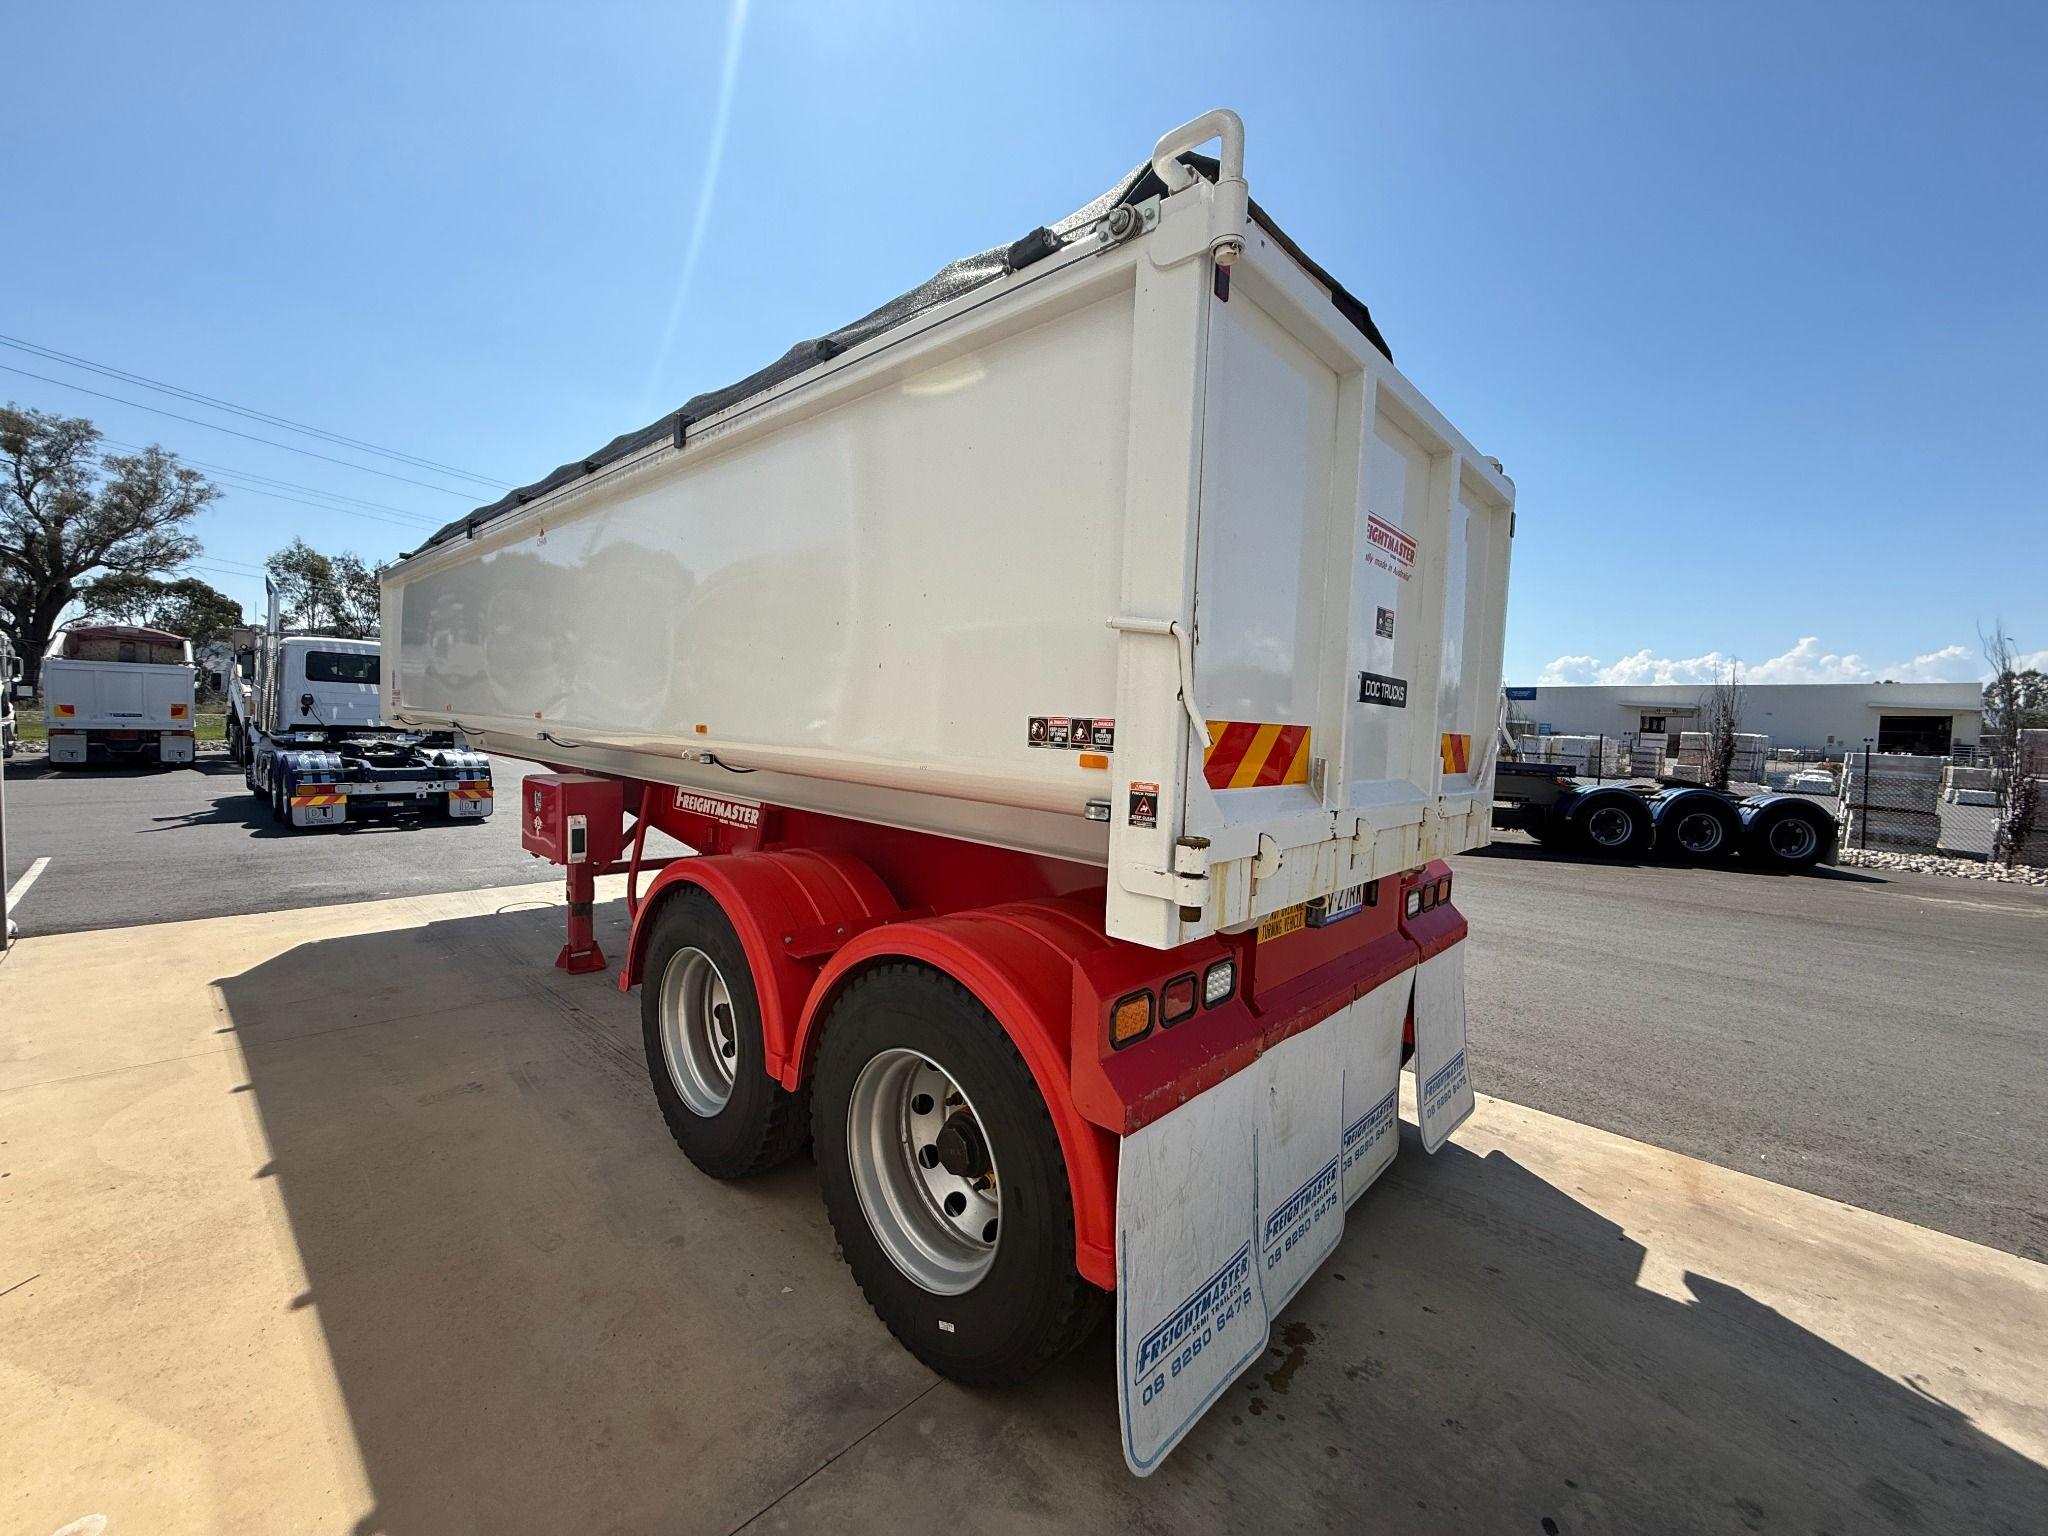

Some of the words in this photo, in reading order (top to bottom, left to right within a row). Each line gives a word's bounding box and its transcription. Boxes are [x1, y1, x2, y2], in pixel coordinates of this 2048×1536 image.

[1365, 680, 1381, 697] DOC
[1381, 683, 1405, 701] TRUCKS
[676, 786, 760, 825] FREIGHTMASTER
[1266, 1167, 1337, 1245] FREIGHTMASTER
[1268, 1247, 1282, 1270] 08
[1138, 1256, 1249, 1375] FREIGHTMASTER
[1192, 1313, 1210, 1335] SEMI
[1212, 1284, 1242, 1316] TRAILERS
[1143, 1372, 1165, 1406] 08
[1217, 1286, 1252, 1332] 6475
